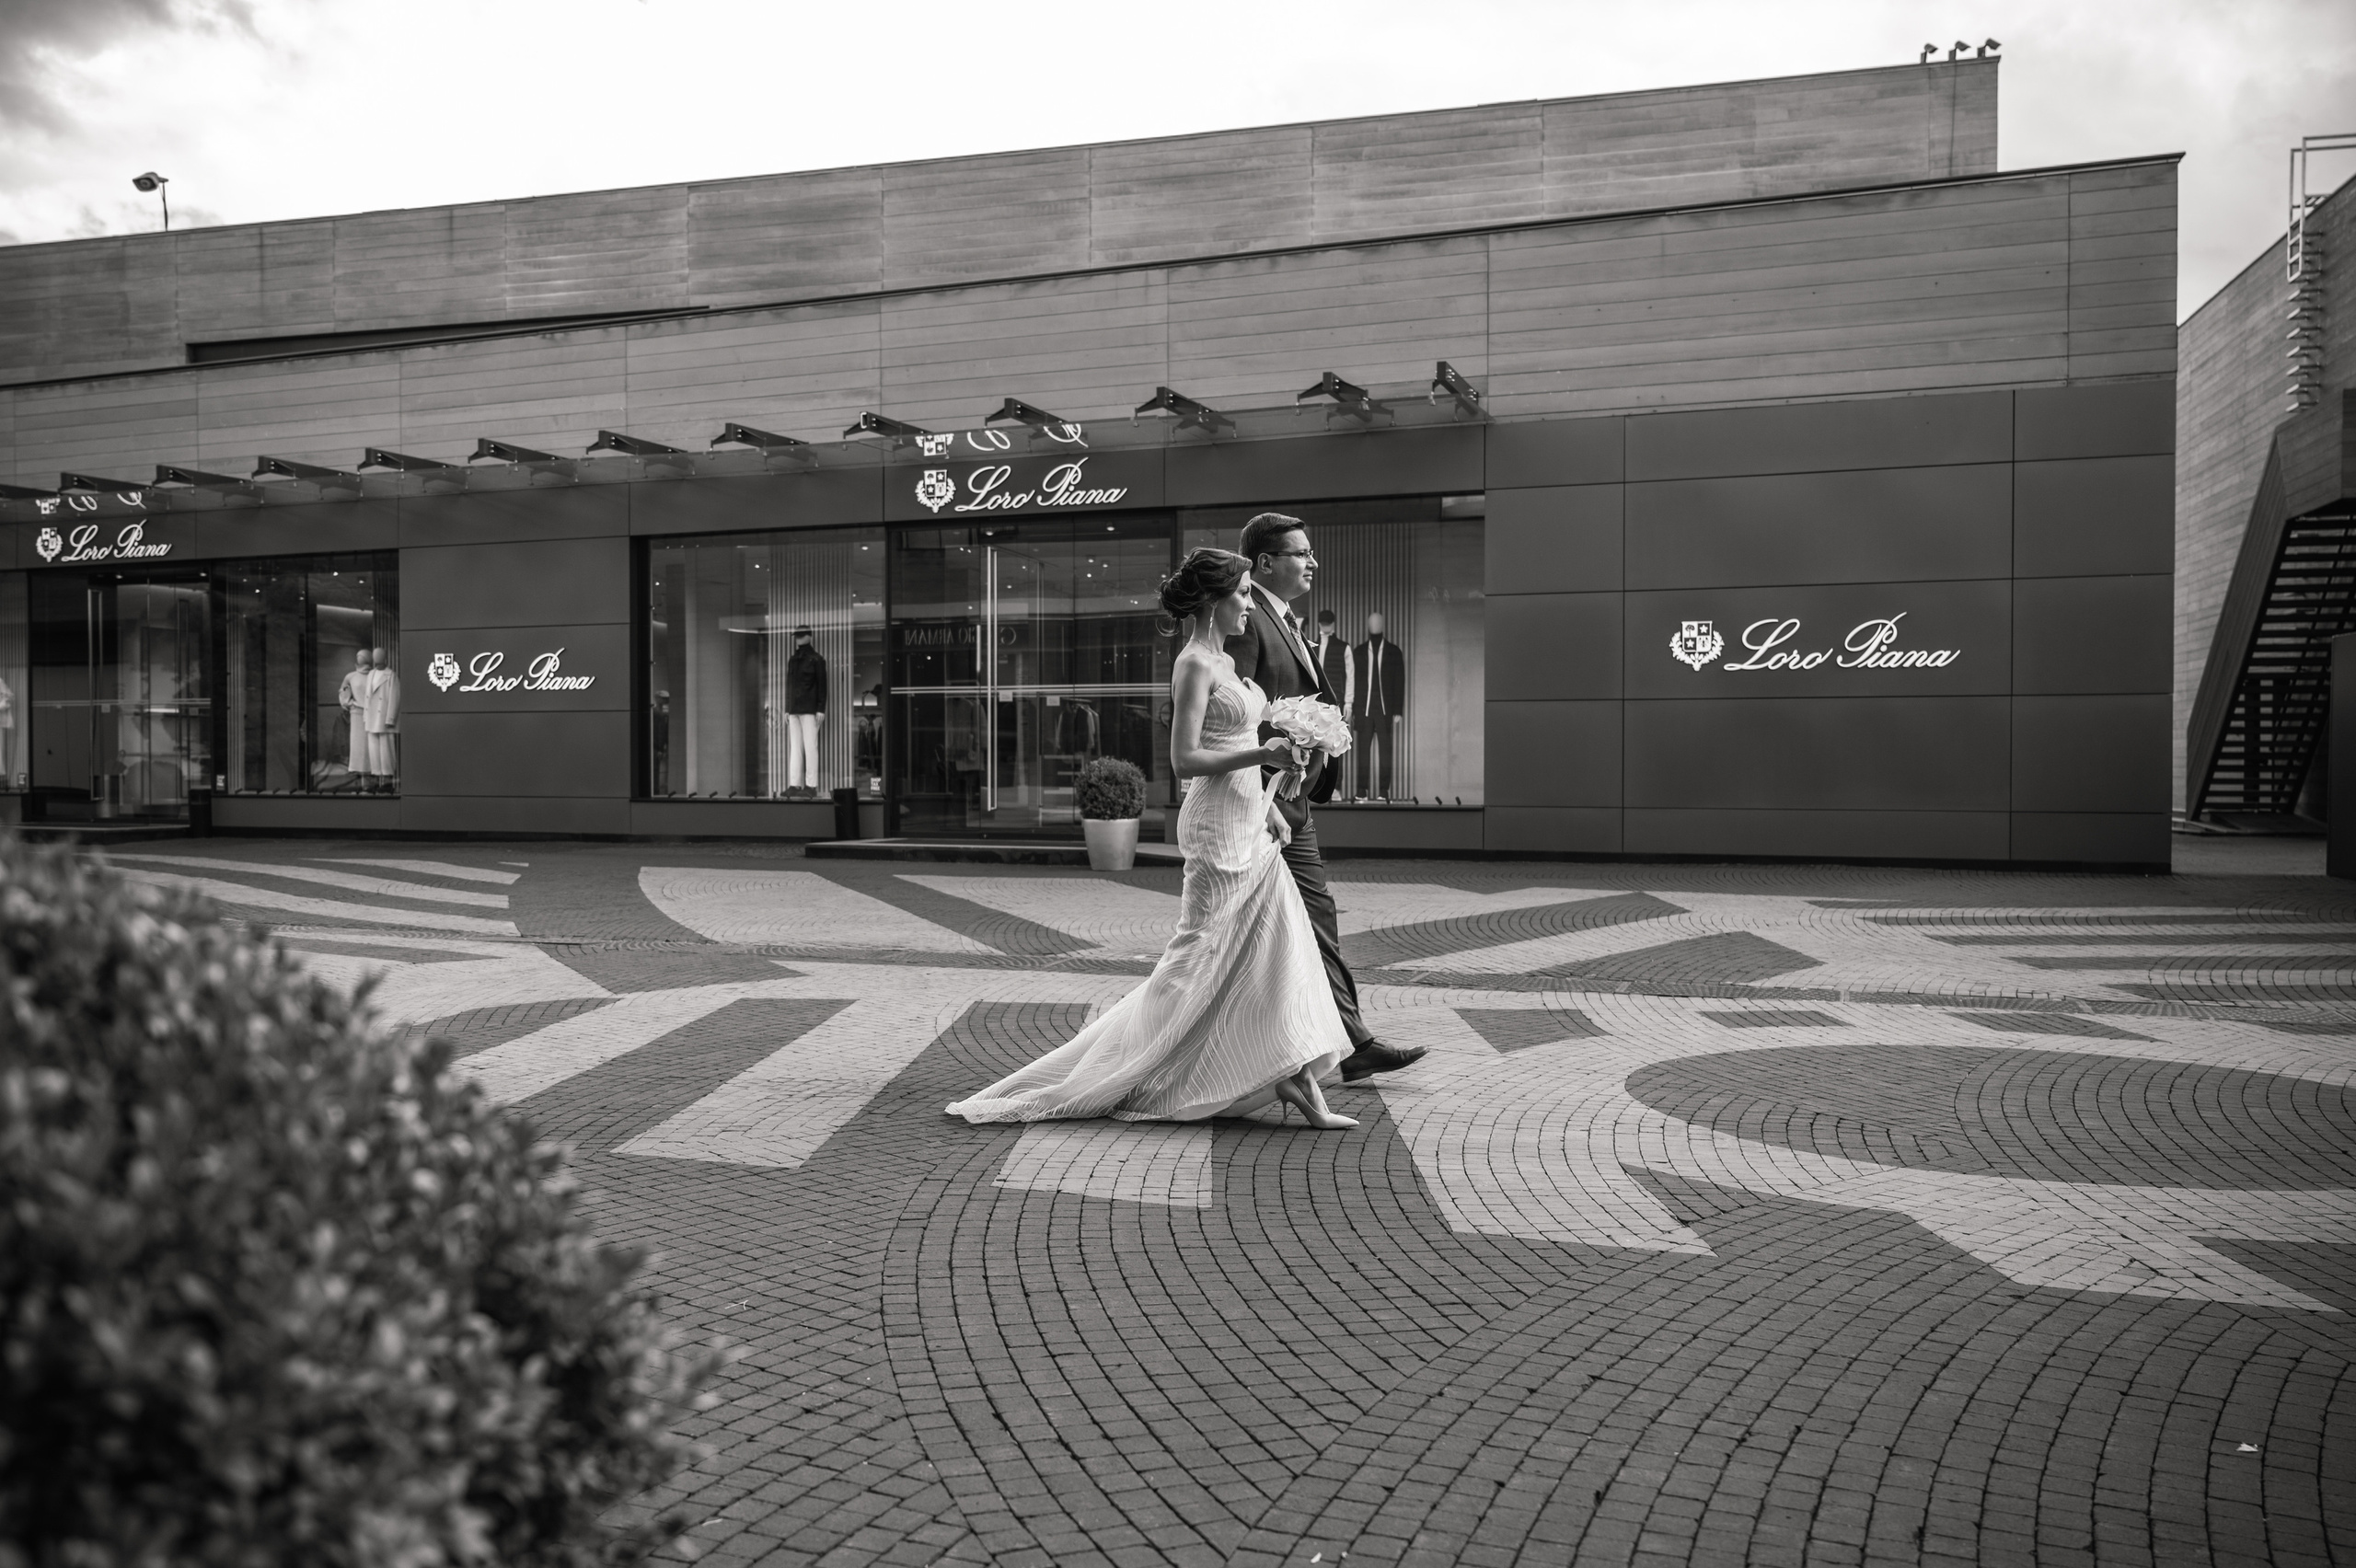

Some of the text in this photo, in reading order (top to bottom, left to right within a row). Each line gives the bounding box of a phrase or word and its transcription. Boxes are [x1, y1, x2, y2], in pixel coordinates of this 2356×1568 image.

[953, 456, 1128, 513] Loro Piana
[61, 518, 172, 562] Loro Piana
[1723, 611, 1961, 671] Loro Piana
[459, 647, 596, 692] Loro Piana
